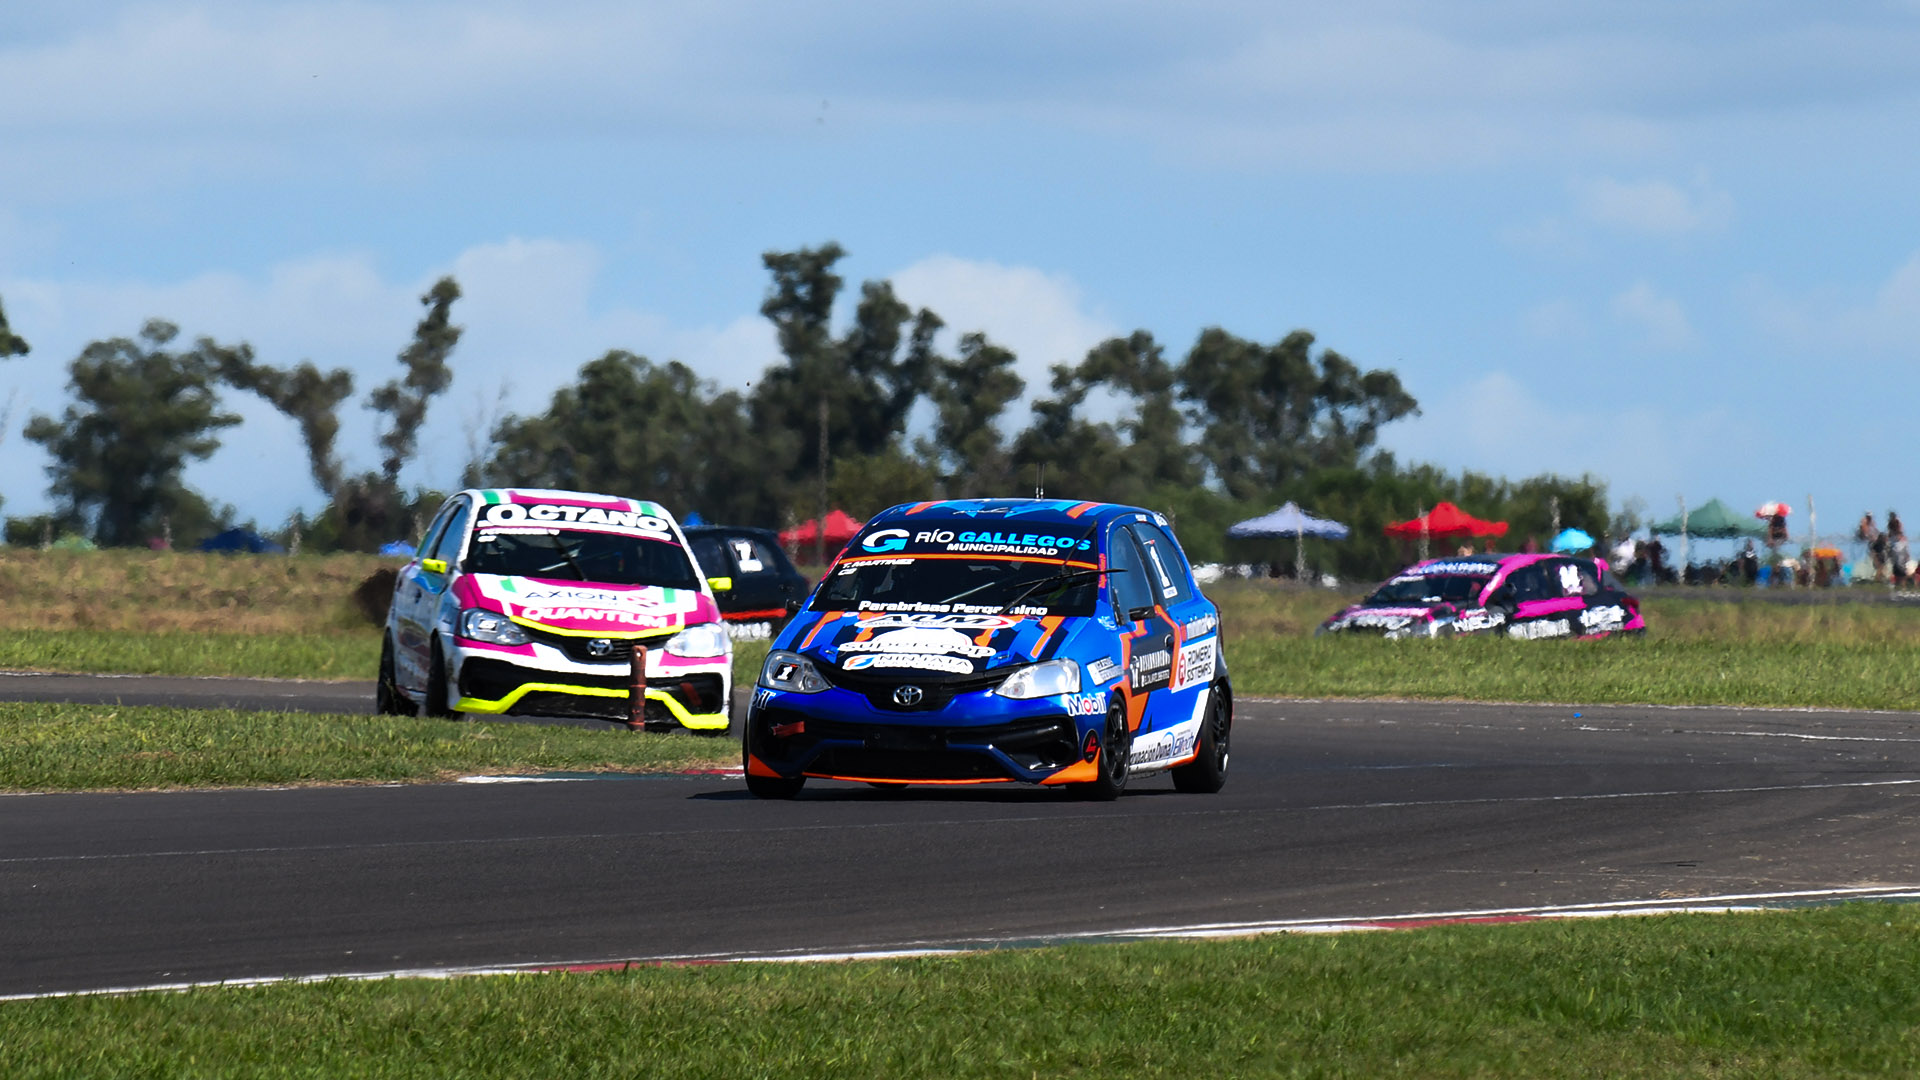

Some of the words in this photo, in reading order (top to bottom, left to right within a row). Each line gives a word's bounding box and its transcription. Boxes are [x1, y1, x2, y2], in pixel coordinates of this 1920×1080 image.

[486, 503, 669, 532] OCTANO
[914, 529, 954, 543] RÍO
[958, 531, 1091, 550] GALLEGOS
[946, 543, 1058, 556] MUNICIPALIDAD
[1150, 547, 1169, 587] 1
[525, 590, 618, 600] AXION
[858, 600, 950, 613] Parabrisas
[522, 607, 668, 628] QUANTIUM
[842, 640, 994, 657] supercoop
[1188, 644, 1211, 666] ROMERO
[777, 666, 793, 680] 1
[1187, 662, 1211, 682] SISTEMAS
[1067, 693, 1106, 715] Mobil
